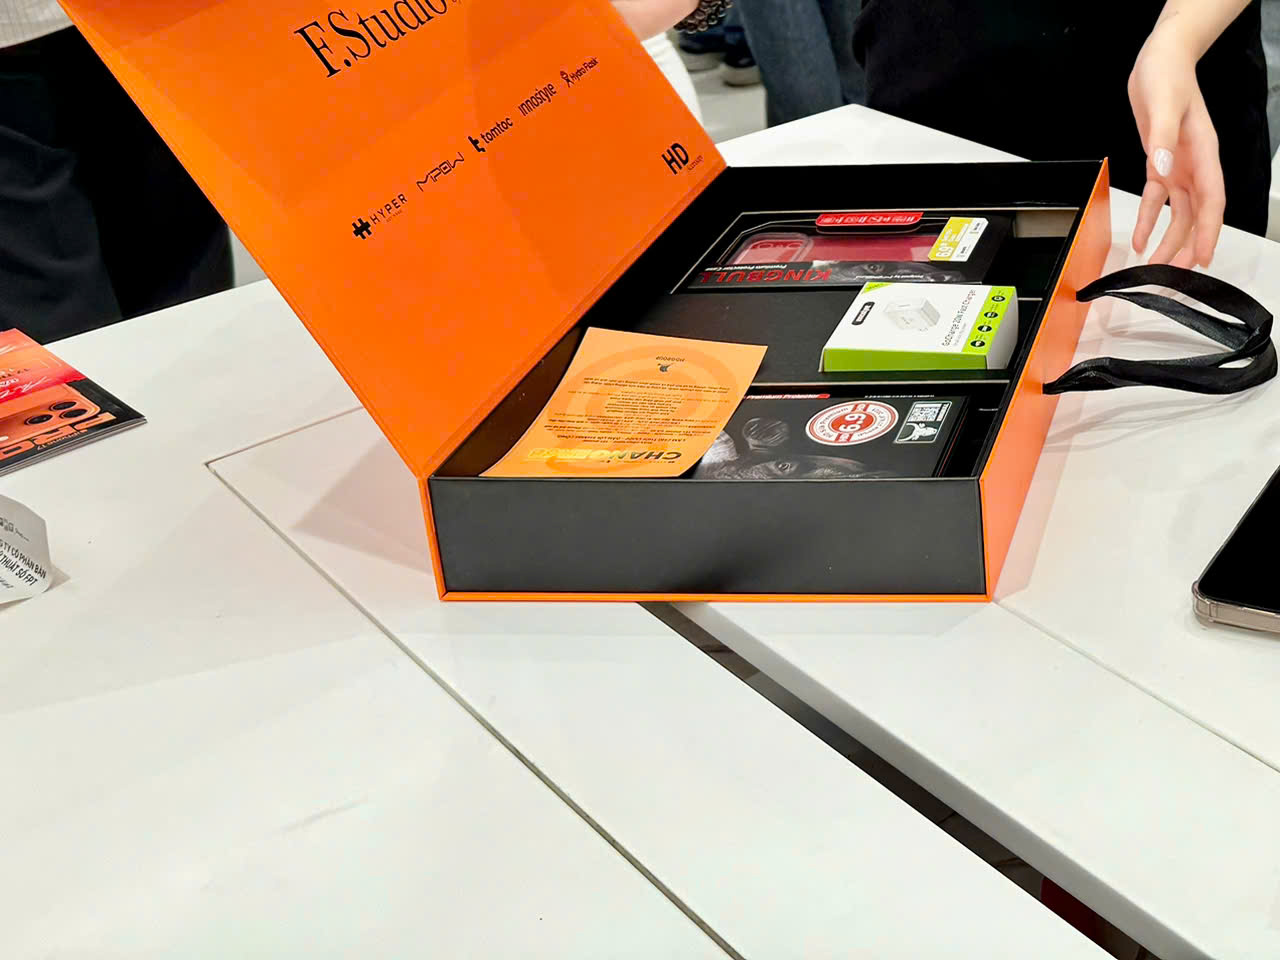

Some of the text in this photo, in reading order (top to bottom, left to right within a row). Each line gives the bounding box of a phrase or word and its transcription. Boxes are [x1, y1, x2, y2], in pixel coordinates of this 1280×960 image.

[370, 193, 408, 225] HYPER
[480, 118, 513, 144] tomtoc
[661, 142, 690, 175] HD
[700, 269, 832, 283] KINGBULL
